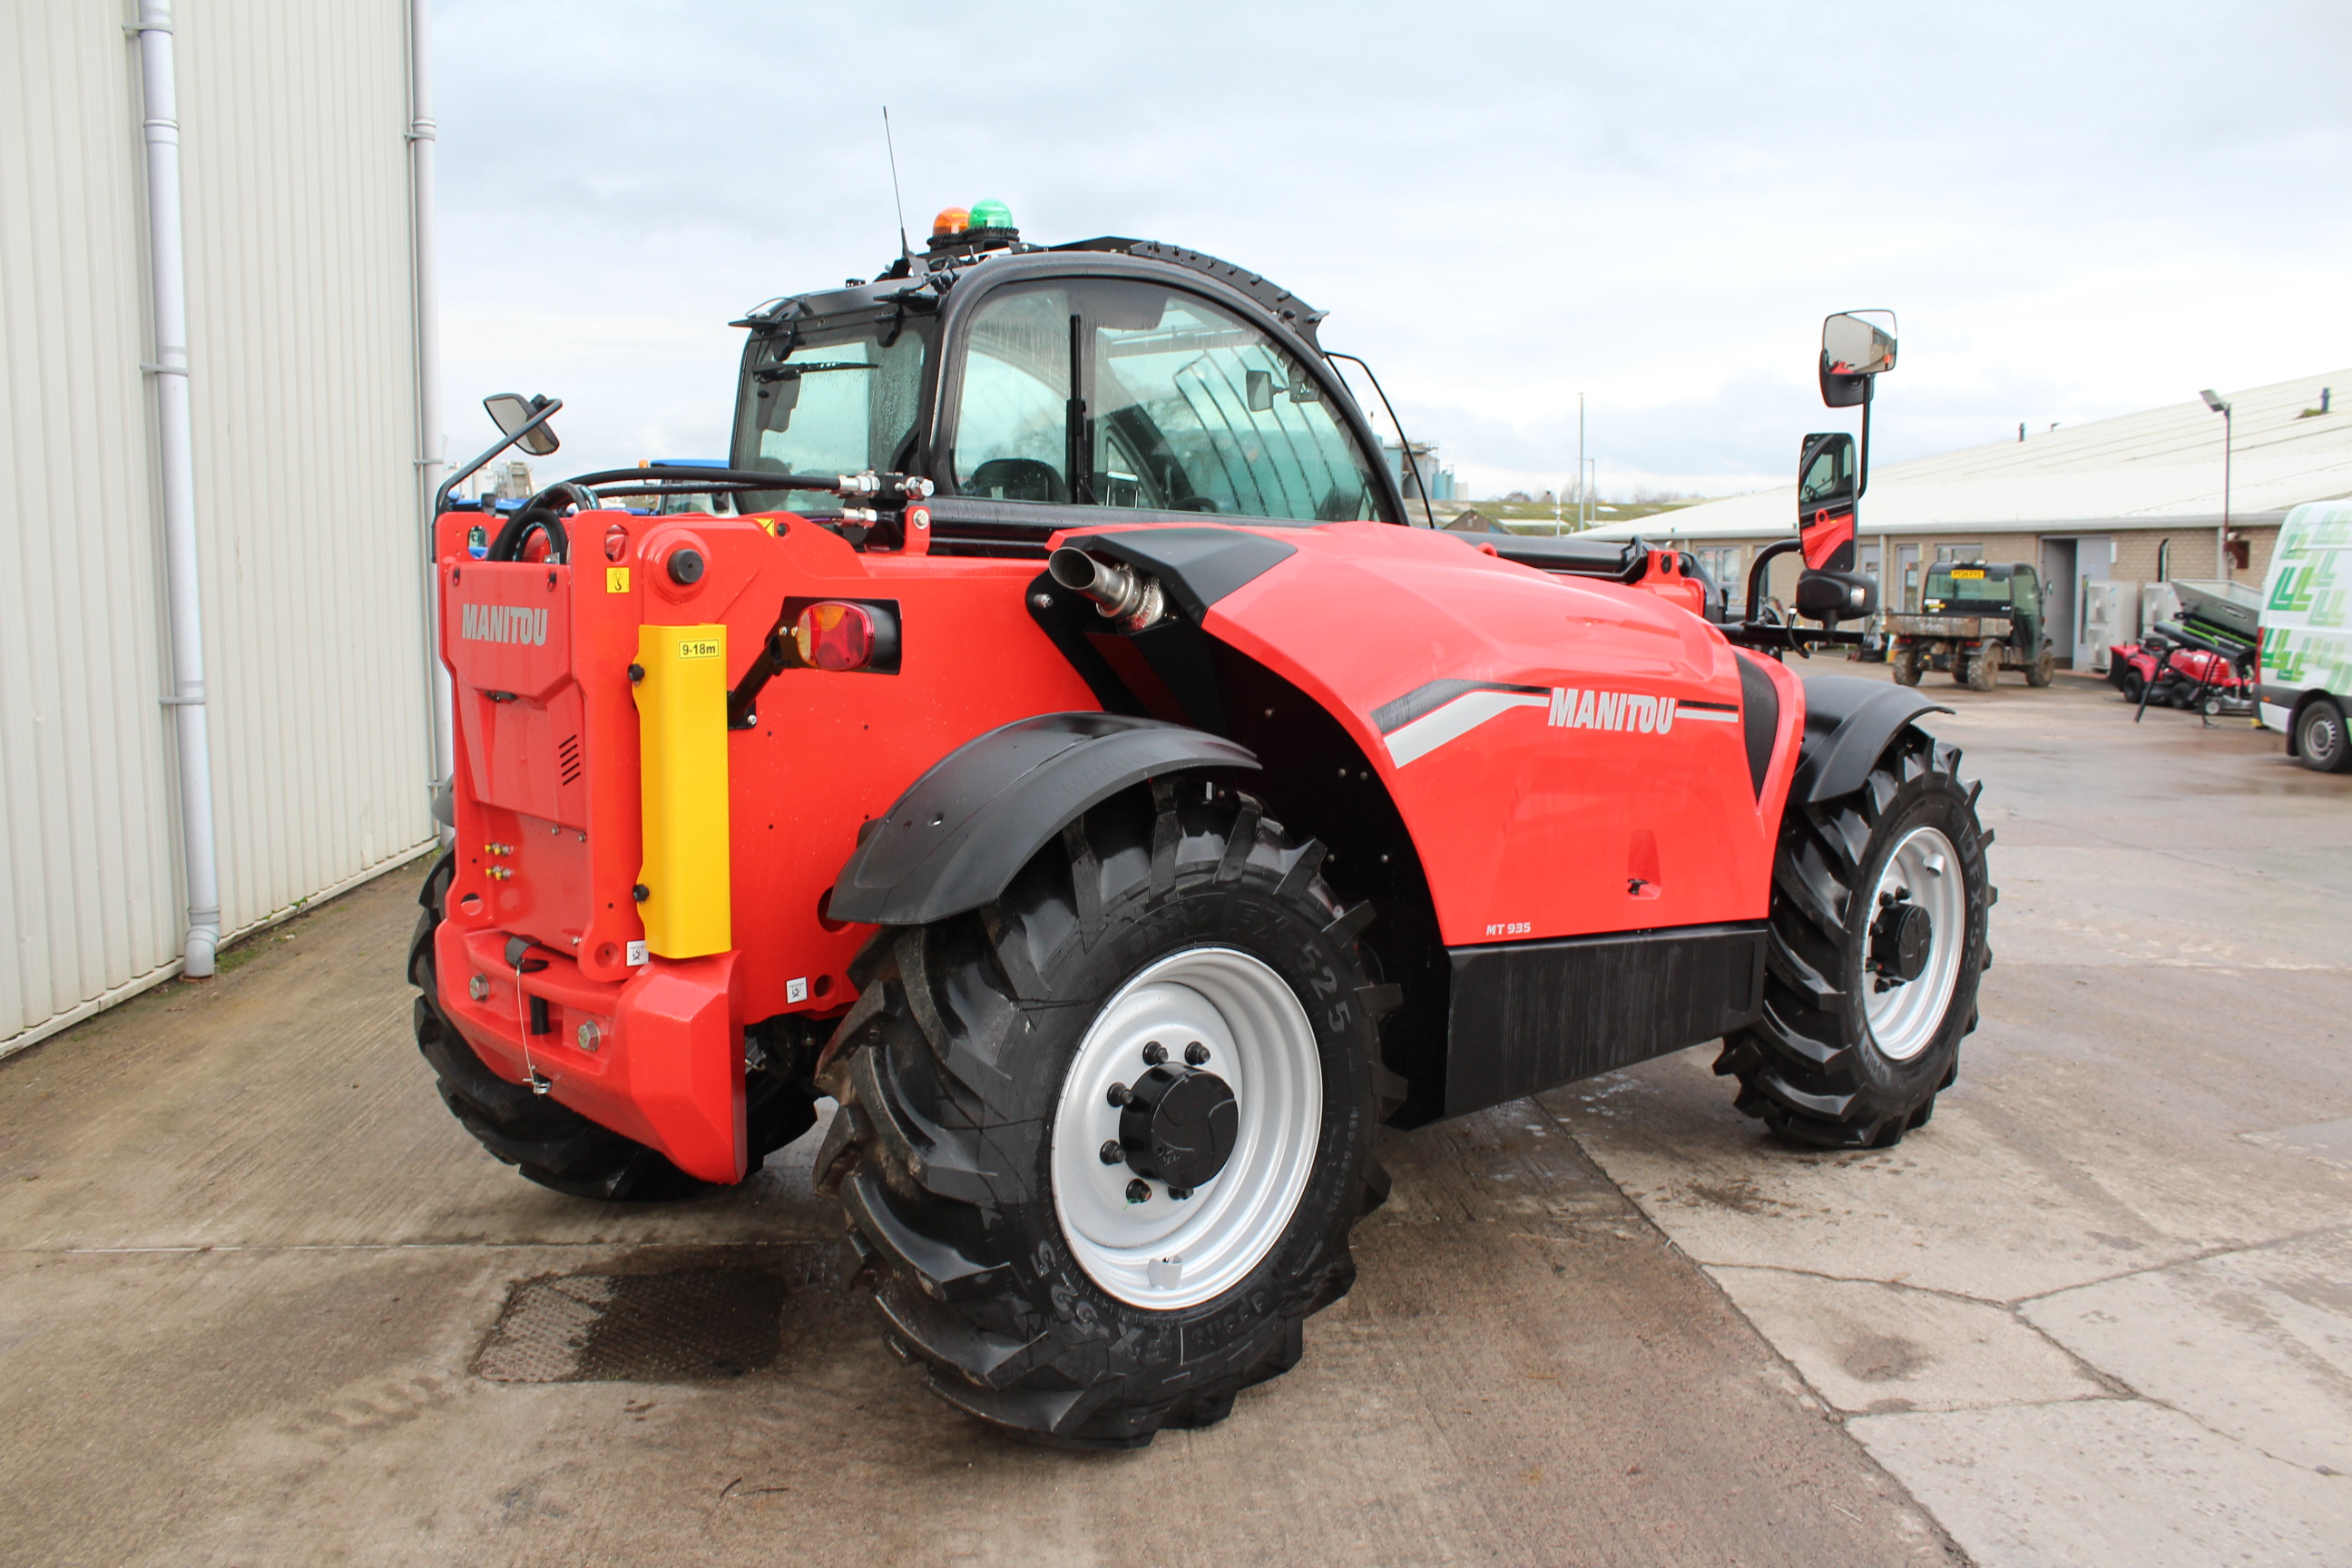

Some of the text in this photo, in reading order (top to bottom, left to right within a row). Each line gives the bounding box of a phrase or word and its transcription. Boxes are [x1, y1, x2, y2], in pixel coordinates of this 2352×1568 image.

[462, 603, 548, 646] MANITOU
[682, 643, 716, 656] 9-18m
[1547, 687, 1676, 735] MANITOU
[1486, 922, 1532, 936] MT 935
